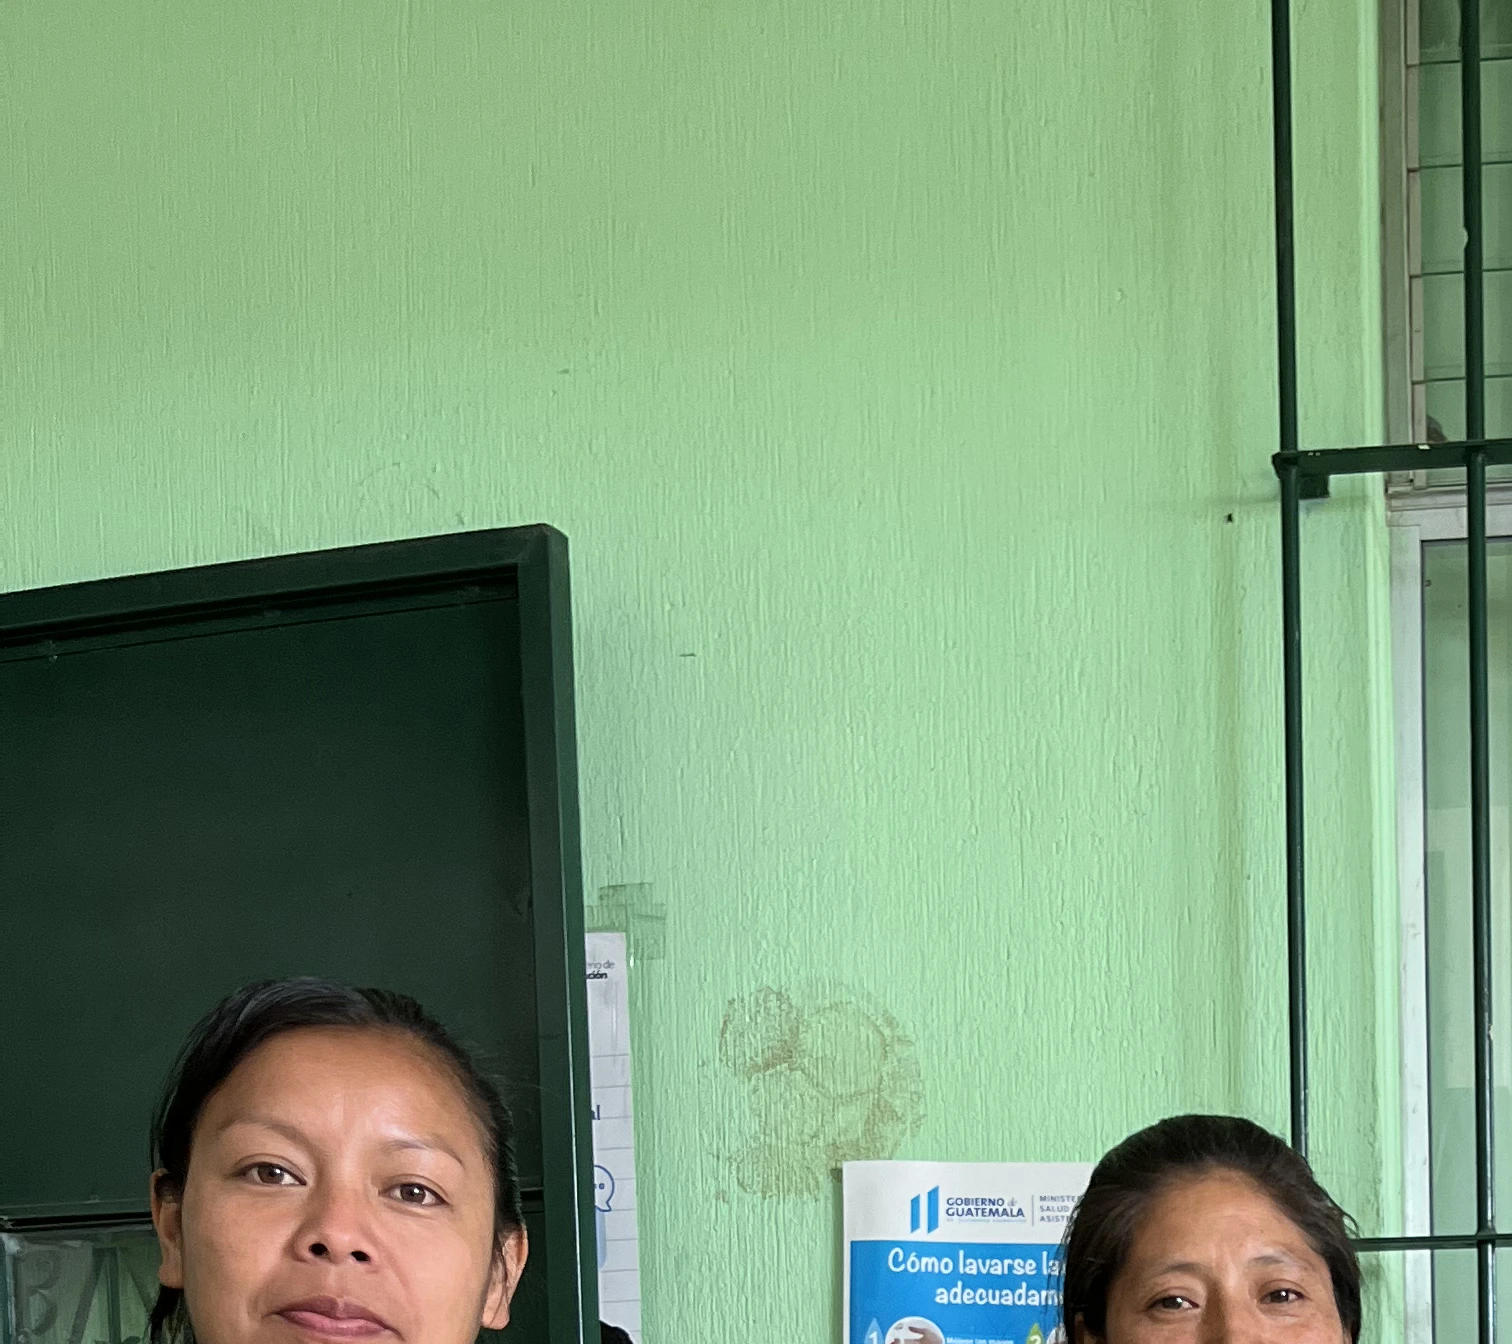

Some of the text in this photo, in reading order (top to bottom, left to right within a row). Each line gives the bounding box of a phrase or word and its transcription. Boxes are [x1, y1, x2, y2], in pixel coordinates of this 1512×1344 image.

[946, 1197, 1004, 1207] GOBIERNO
[946, 1208, 1025, 1217] GUATEMALA
[888, 1247, 953, 1274] Cómo
[959, 1250, 1037, 1275] lavarse
[934, 1280, 1063, 1306] adecuadam
